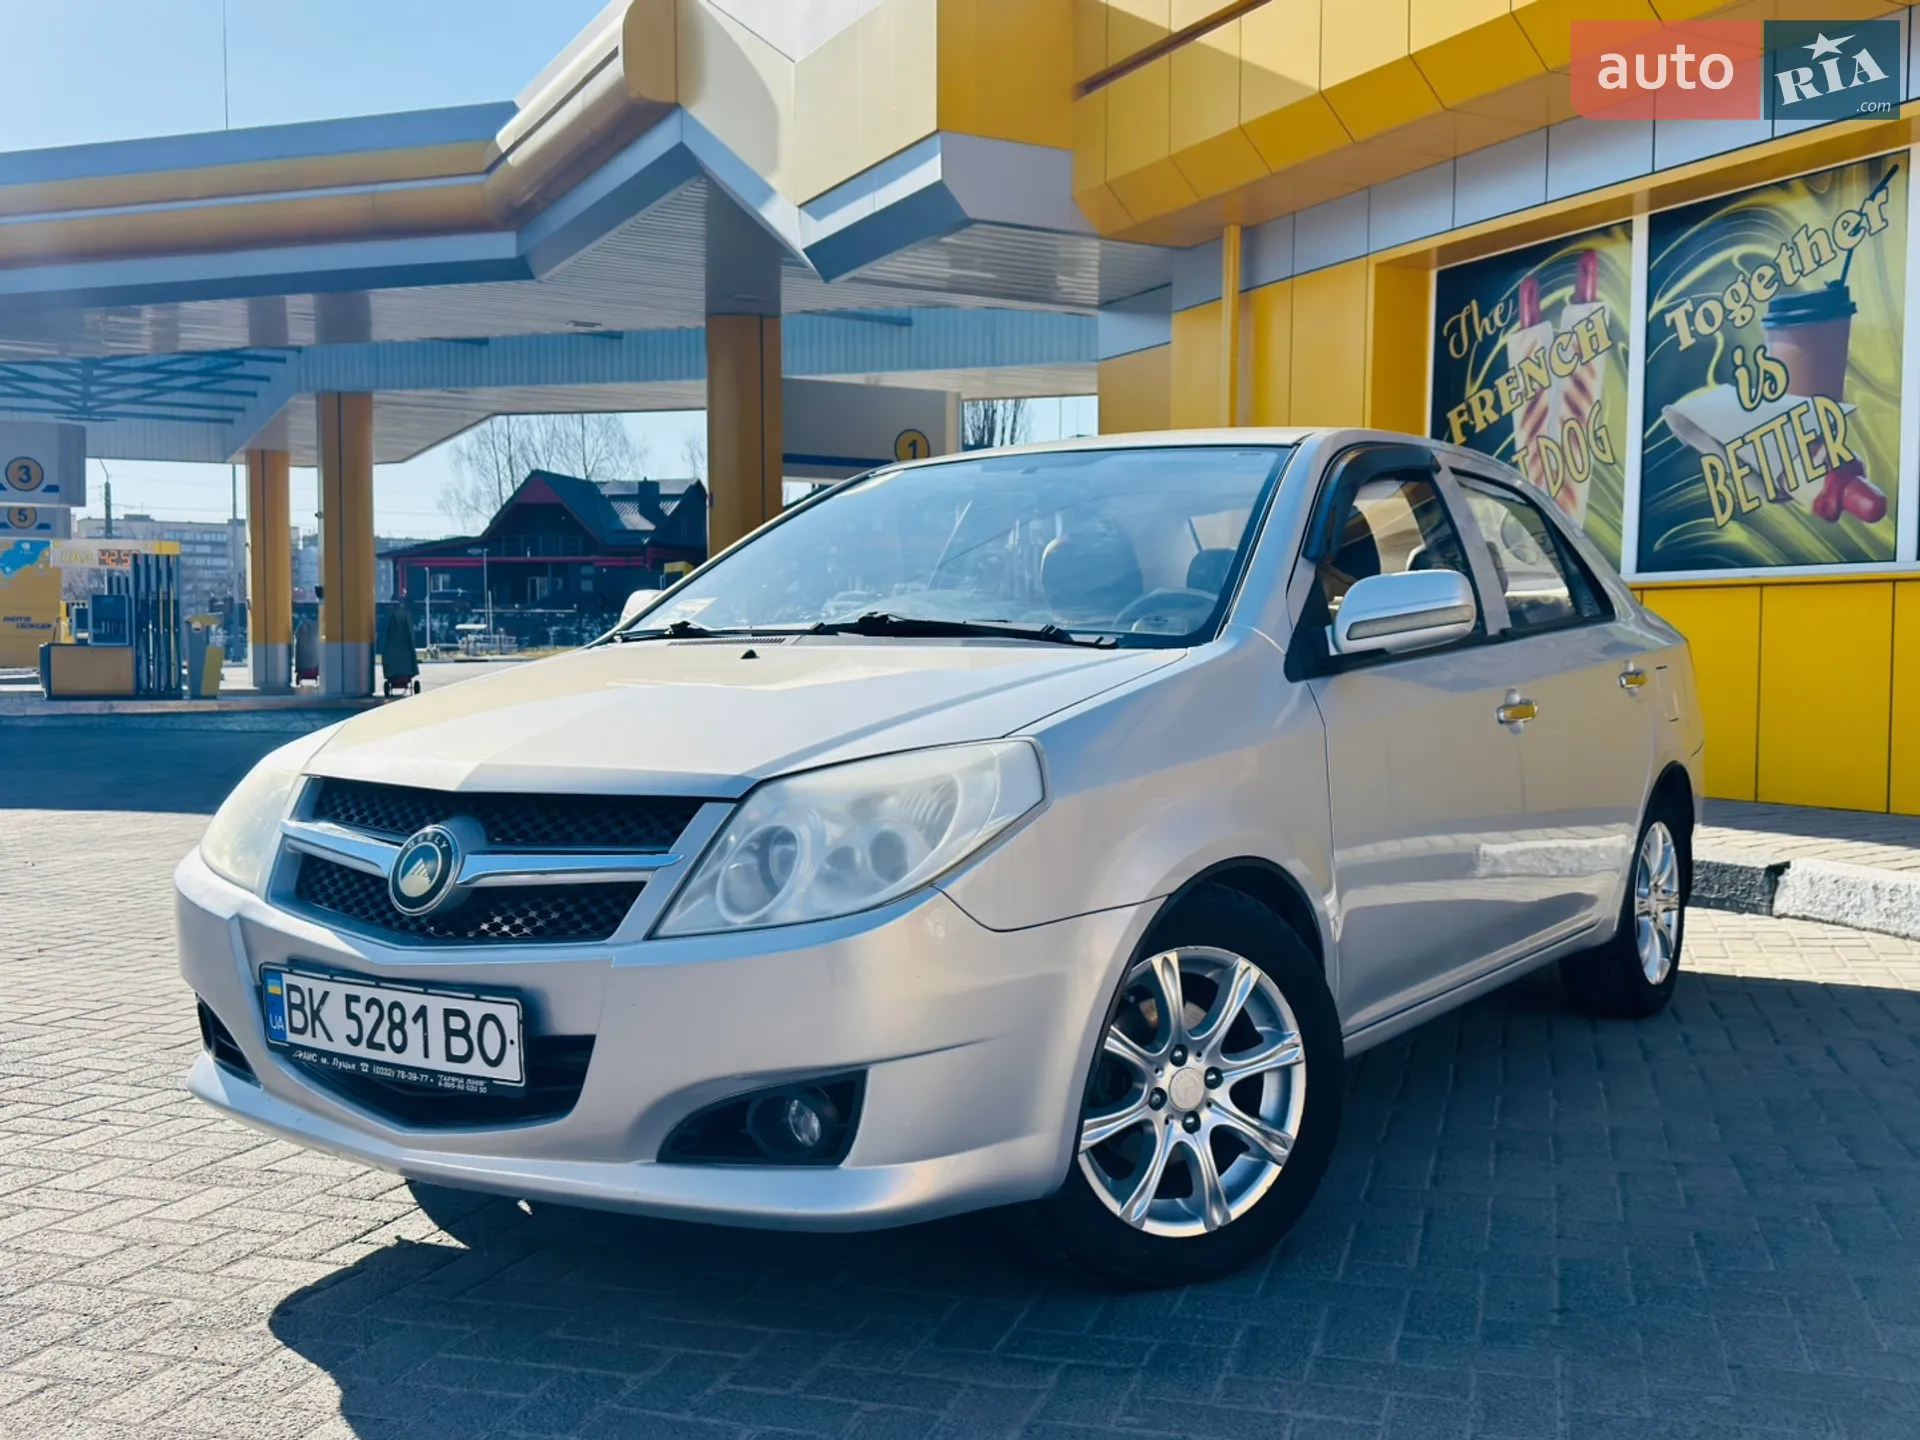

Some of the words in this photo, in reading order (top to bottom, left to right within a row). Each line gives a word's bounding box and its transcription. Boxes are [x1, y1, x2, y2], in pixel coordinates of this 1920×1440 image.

[1664, 187, 1890, 353] Together
[1441, 297, 1516, 360] The
[1446, 306, 1614, 447] FRENCH
[1732, 344, 1789, 411] is
[18, 464, 32, 485] 3
[908, 439, 917, 460] 1
[1537, 401, 1615, 499] DOG
[1700, 395, 1855, 529] BETTER
[17, 507, 28, 523] 5
[407, 833, 449, 849] GEELY
[268, 1013, 285, 1031] UA
[285, 983, 334, 1043] BK
[345, 993, 430, 1059] 5281
[442, 1008, 507, 1068] BO
